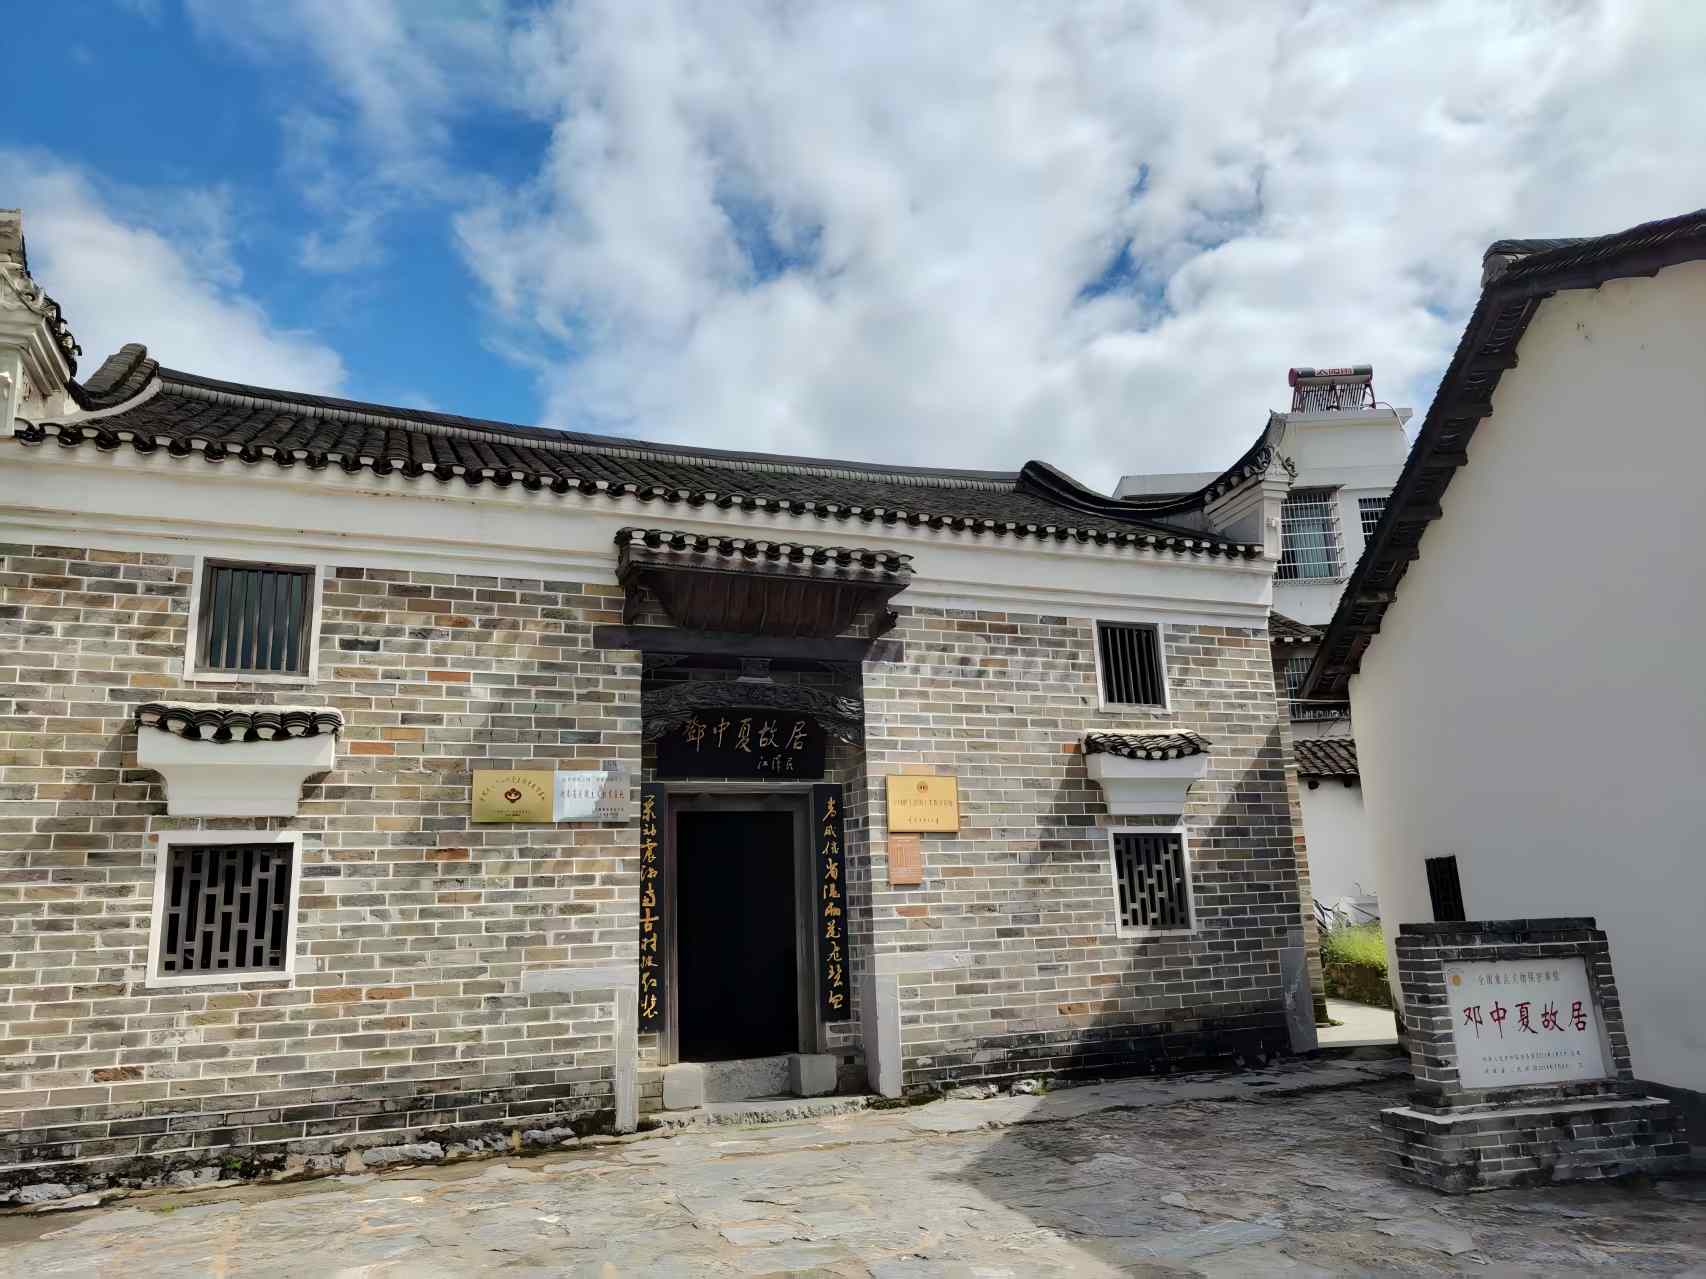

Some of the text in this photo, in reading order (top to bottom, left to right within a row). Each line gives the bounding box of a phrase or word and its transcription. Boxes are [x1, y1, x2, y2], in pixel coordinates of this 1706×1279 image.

[686, 716, 807, 752] 鄧中夏故居
[1463, 1000, 1587, 1039] 邓中夏故居
